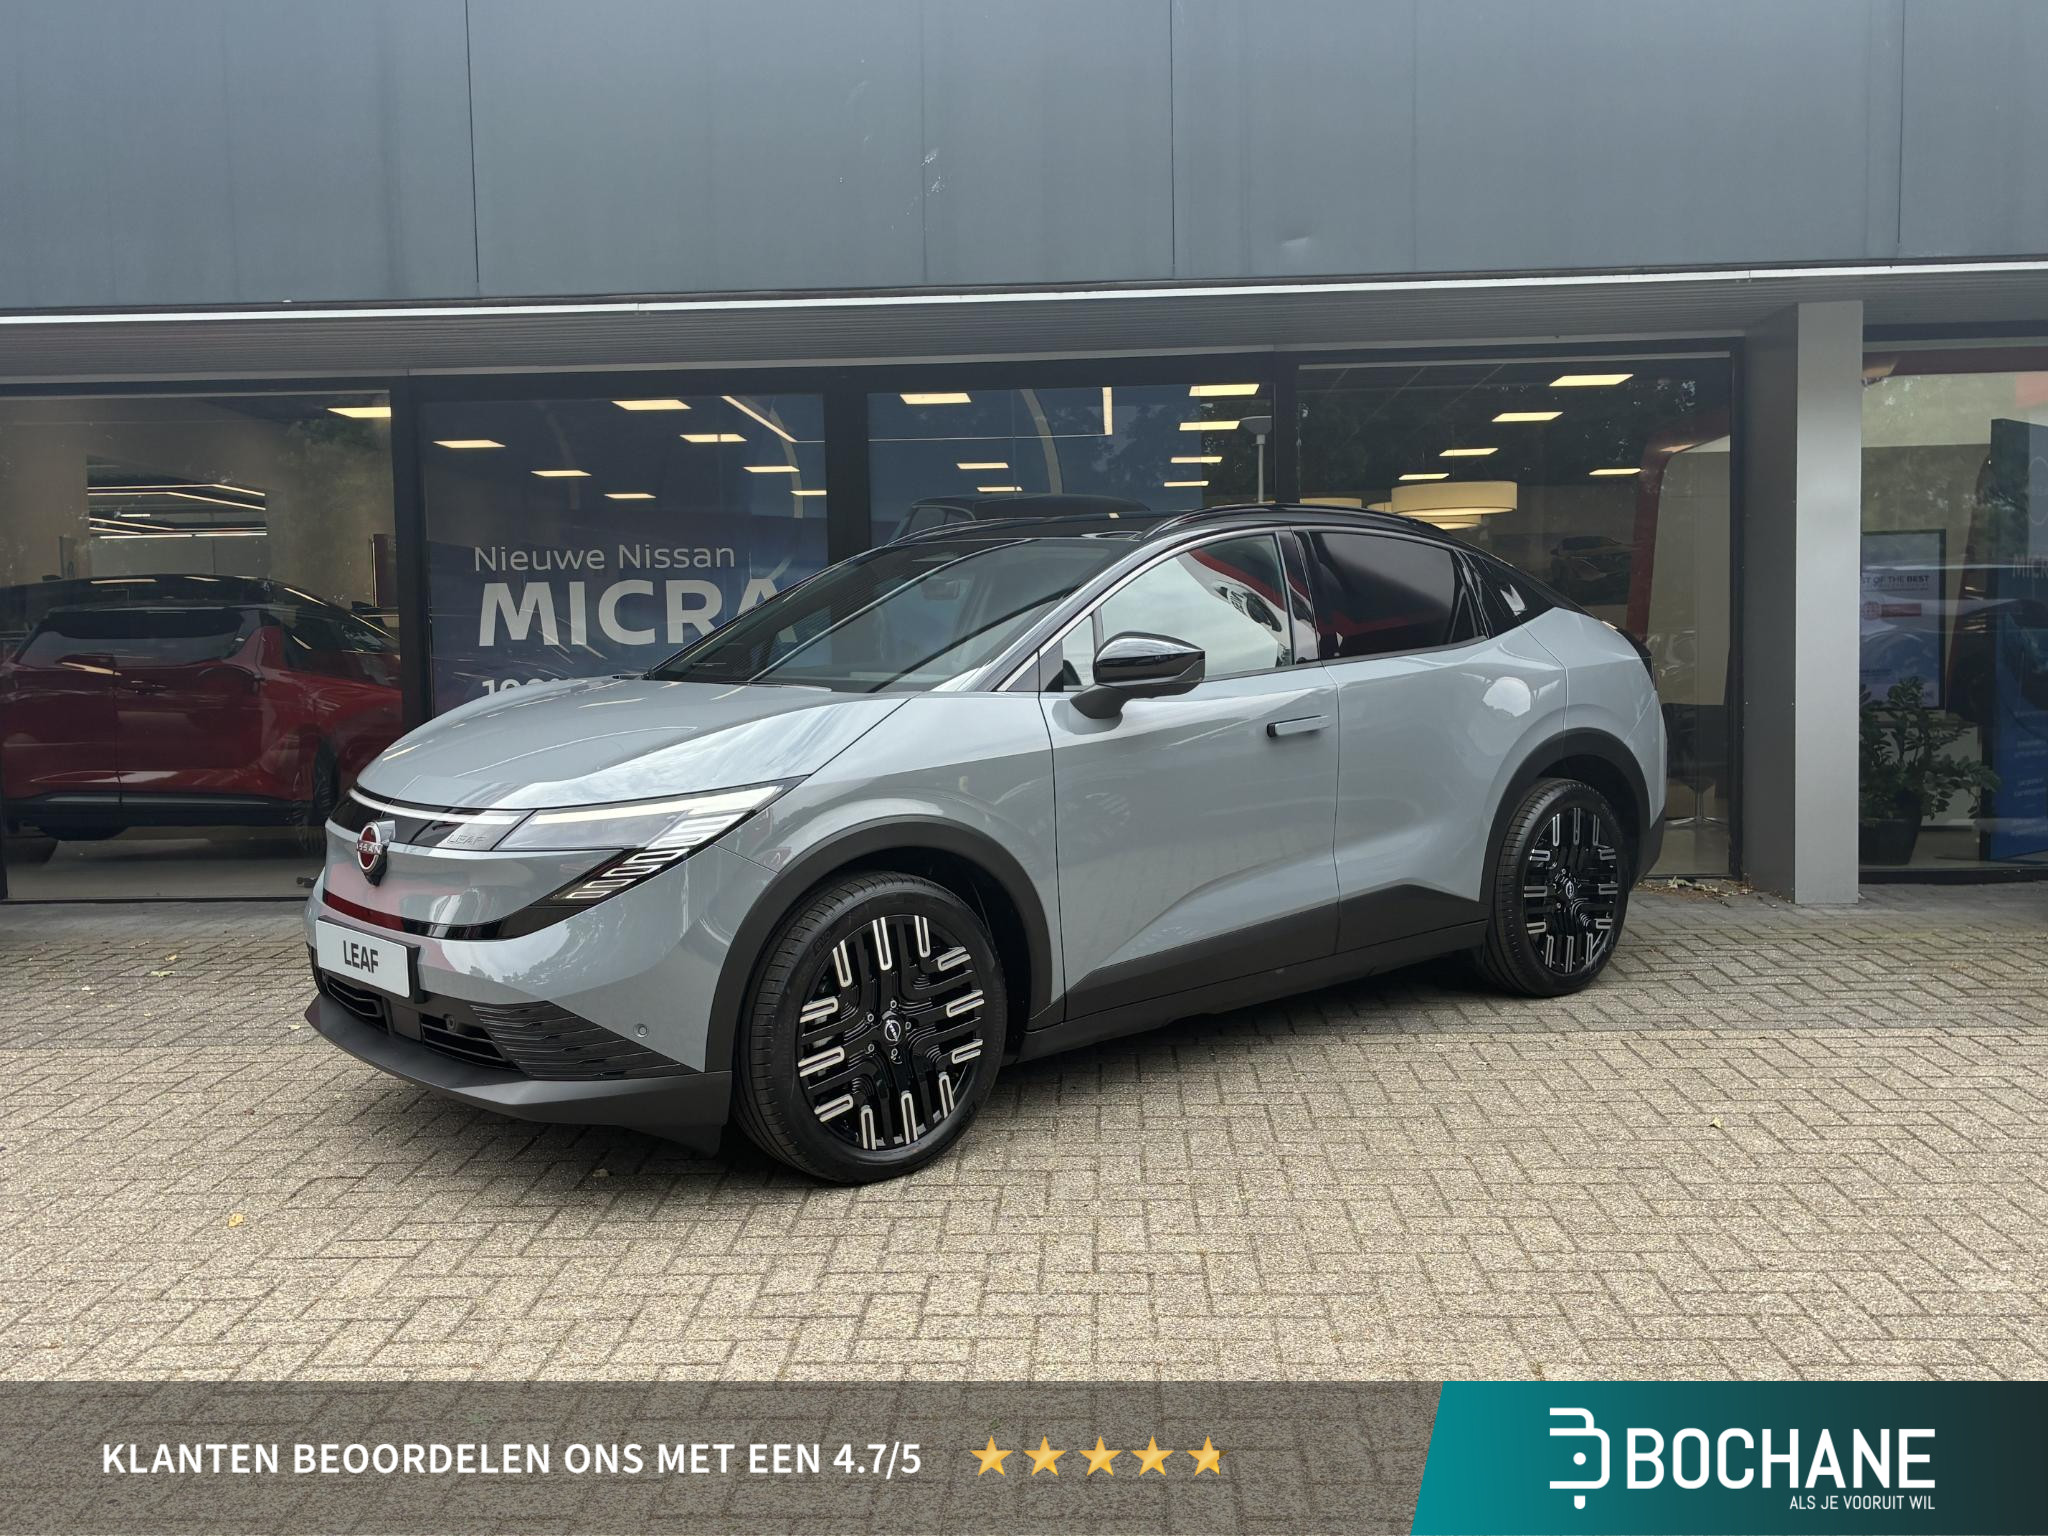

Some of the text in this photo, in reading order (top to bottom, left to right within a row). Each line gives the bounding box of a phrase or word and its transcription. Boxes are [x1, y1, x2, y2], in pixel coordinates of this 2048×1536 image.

[474, 543, 736, 572] Nieuwe Nissan
[2012, 553, 2048, 578] MICR
[356, 841, 382, 854] ISSAN
[447, 834, 486, 846] LEAF
[343, 940, 379, 974] LEAF
